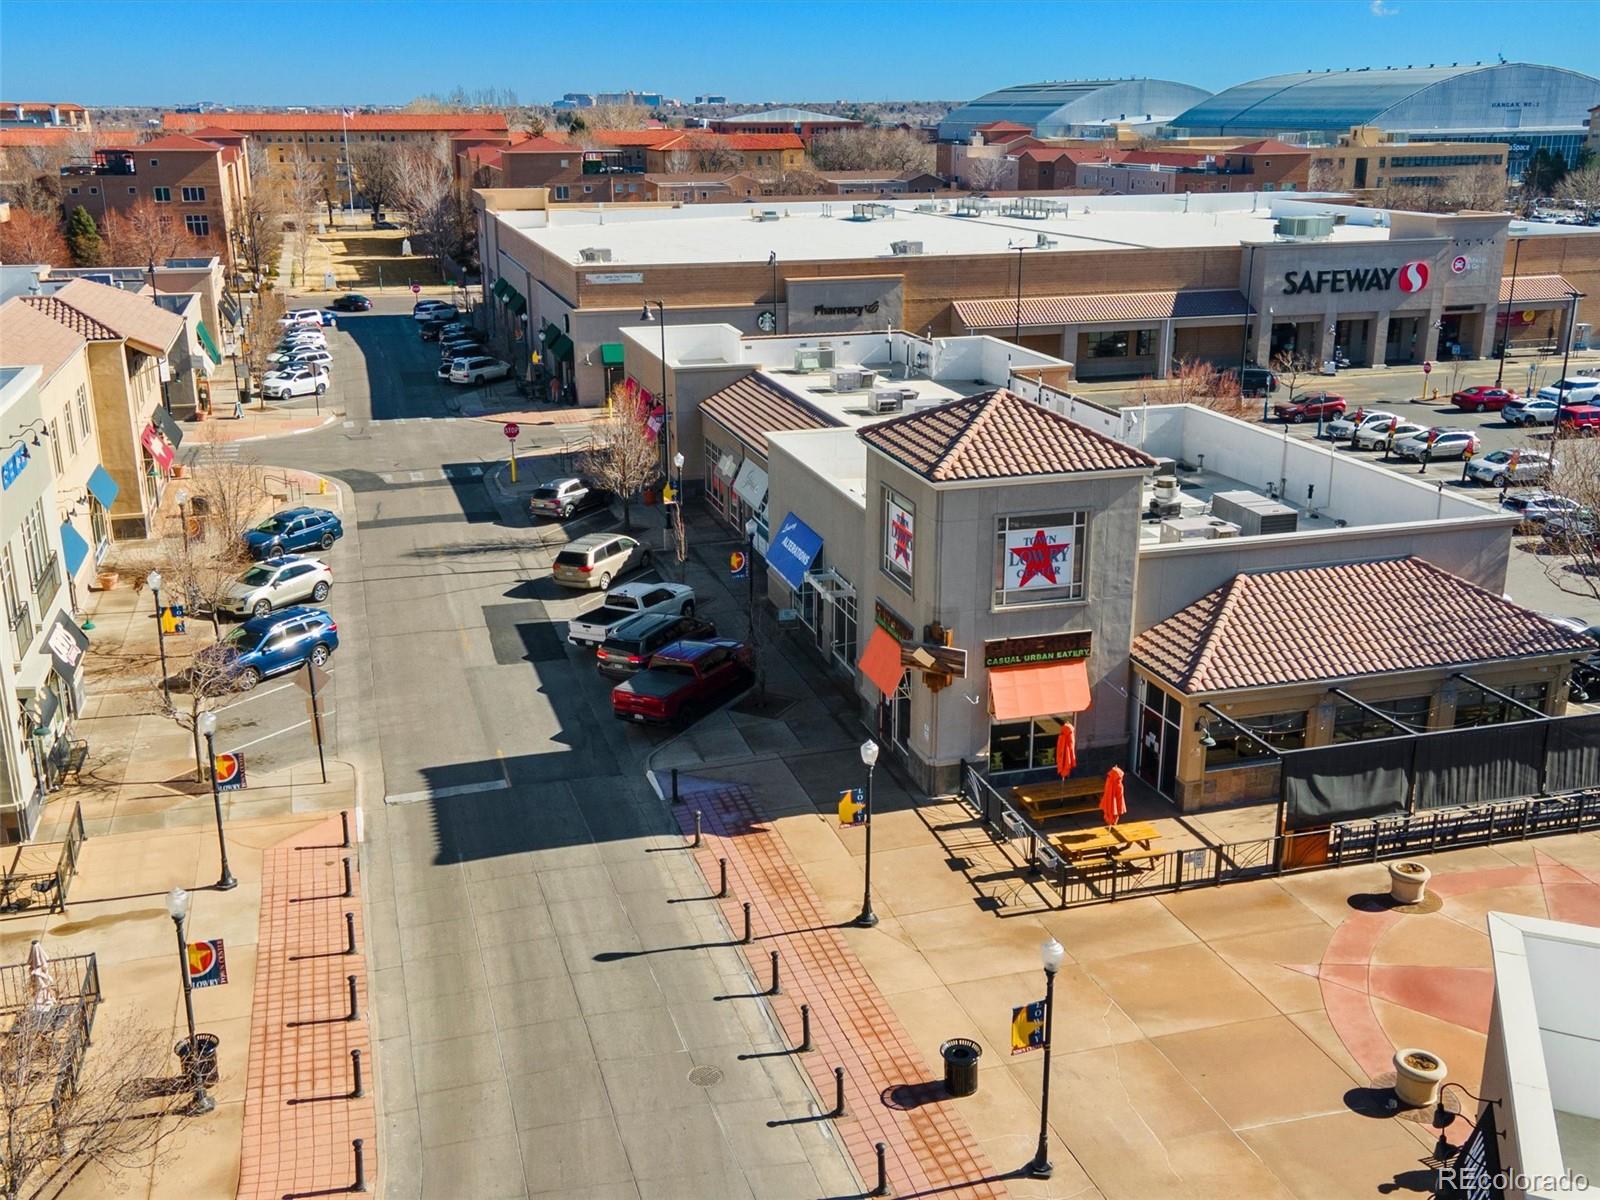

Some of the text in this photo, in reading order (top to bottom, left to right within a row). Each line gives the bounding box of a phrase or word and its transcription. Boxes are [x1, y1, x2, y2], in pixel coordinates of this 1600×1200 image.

[1284, 267, 1399, 295] SAFEWAY
[814, 304, 864, 316] Pharmacy
[1023, 534, 1057, 546] TOWN
[782, 536, 810, 566] ALTERATIONS
[1009, 547, 1069, 567] LOWRY
[987, 648, 1090, 666] CASUAL URBAN EATERY
[192, 979, 218, 989] LOWRY
